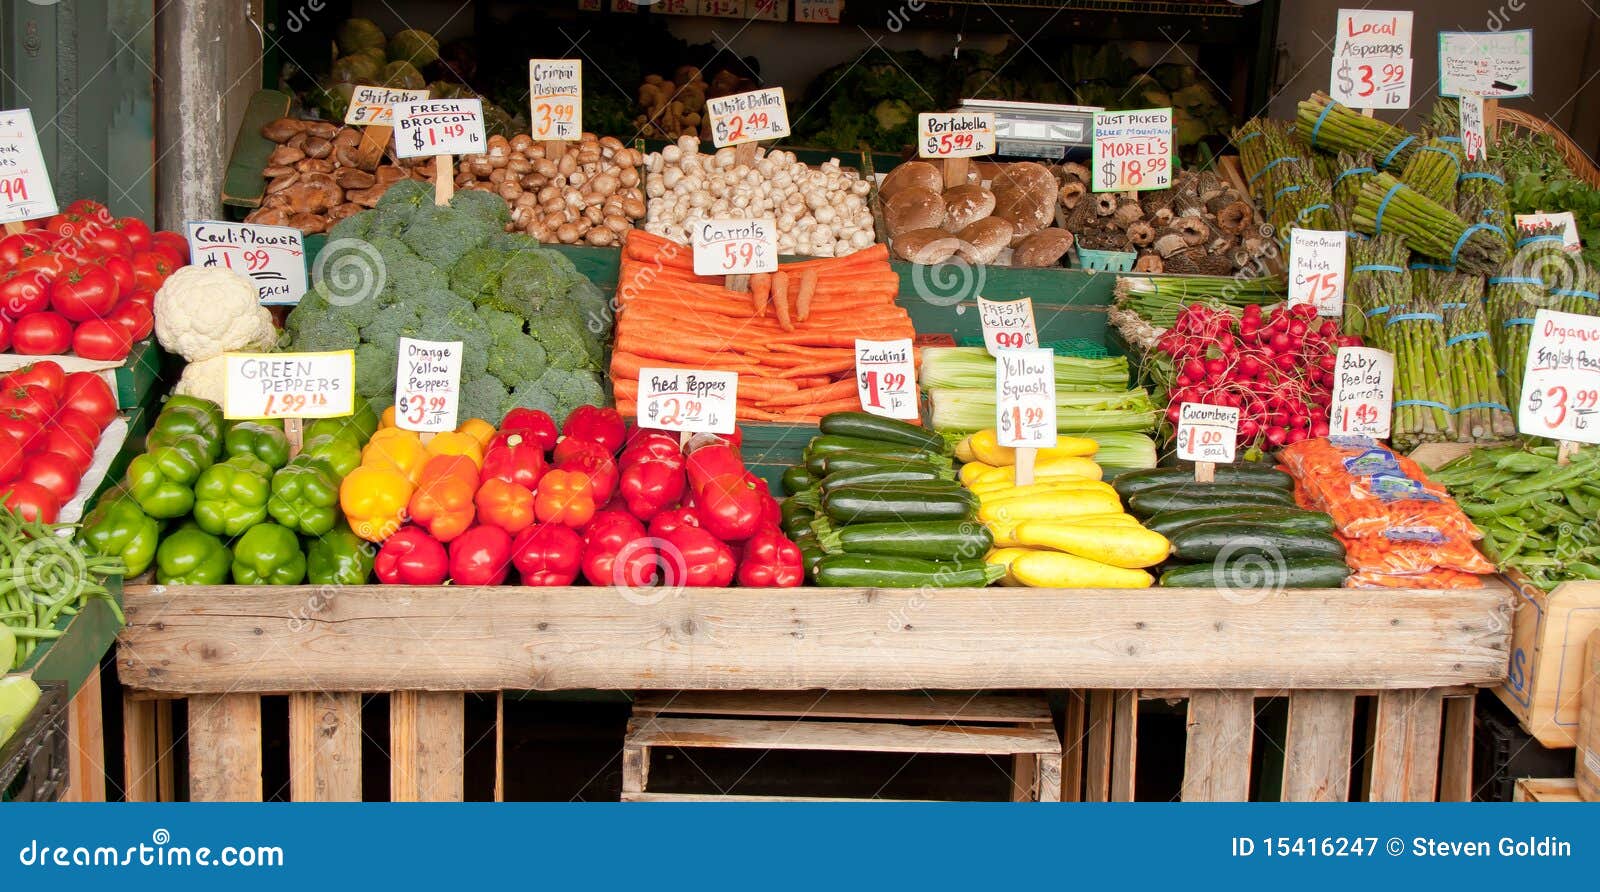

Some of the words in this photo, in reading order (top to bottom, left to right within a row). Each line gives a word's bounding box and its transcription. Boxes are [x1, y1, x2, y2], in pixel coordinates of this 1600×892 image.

[1348, 16, 1397, 37] Local
[712, 97, 746, 116] White
[1386, 92, 1400, 104] lb
[410, 104, 460, 115] FRESH
[401, 114, 476, 130] BROCCOLI
[928, 117, 987, 133] Portabella
[1097, 115, 1124, 126] JUST
[1129, 114, 1168, 125] PICKED
[469, 132, 479, 143] lb
[703, 222, 764, 242] Carrots
[259, 285, 290, 299] EACH
[408, 344, 451, 361] Orange
[860, 348, 907, 363] Zucchini
[240, 359, 312, 379] GREEN
[409, 360, 448, 377] Yellow
[1002, 356, 1045, 380] Yellow
[1342, 353, 1377, 372] Baby
[261, 378, 340, 394] PEPPERS
[408, 377, 449, 393] Peppers
[651, 374, 679, 392] Red
[686, 375, 726, 398] Peppers
[1341, 370, 1381, 389] Peeled
[1002, 378, 1047, 401] Squash
[1339, 386, 1384, 402] Carrots
[263, 394, 306, 416] 1.99
[1182, 404, 1237, 424] Cucumbers
